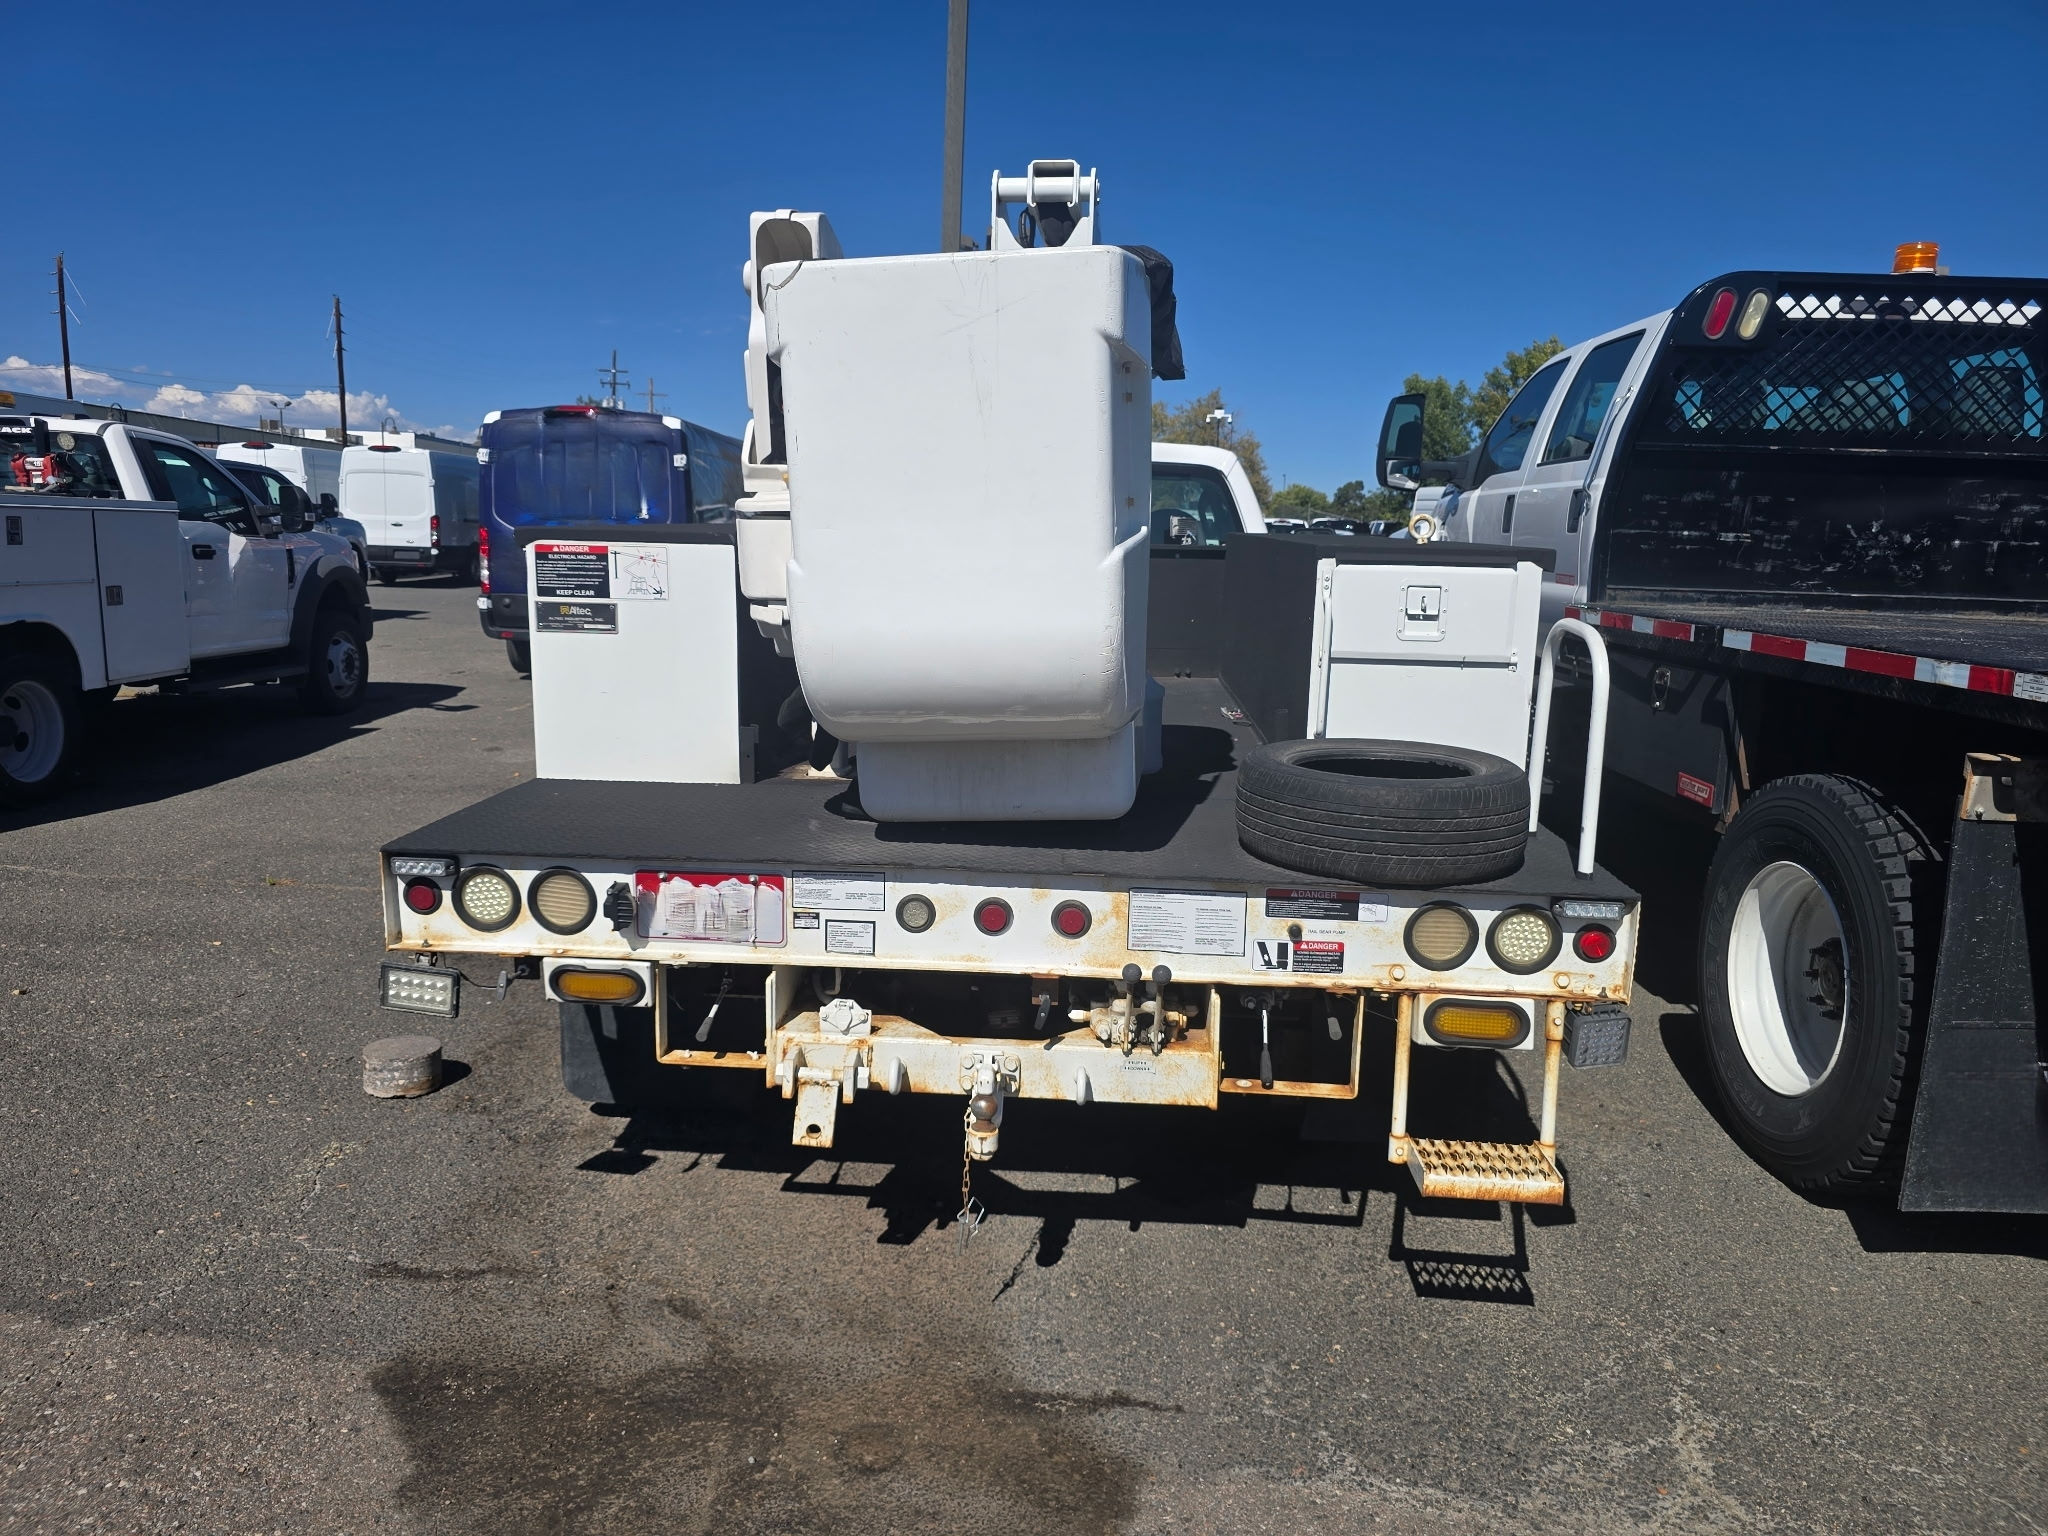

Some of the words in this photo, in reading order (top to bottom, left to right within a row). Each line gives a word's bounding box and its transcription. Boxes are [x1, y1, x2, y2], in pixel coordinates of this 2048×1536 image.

[559, 545, 590, 553] DANGER
[569, 606, 592, 615] Altec
[1298, 890, 1337, 899] DANGER
[1308, 942, 1339, 950] DANGER
